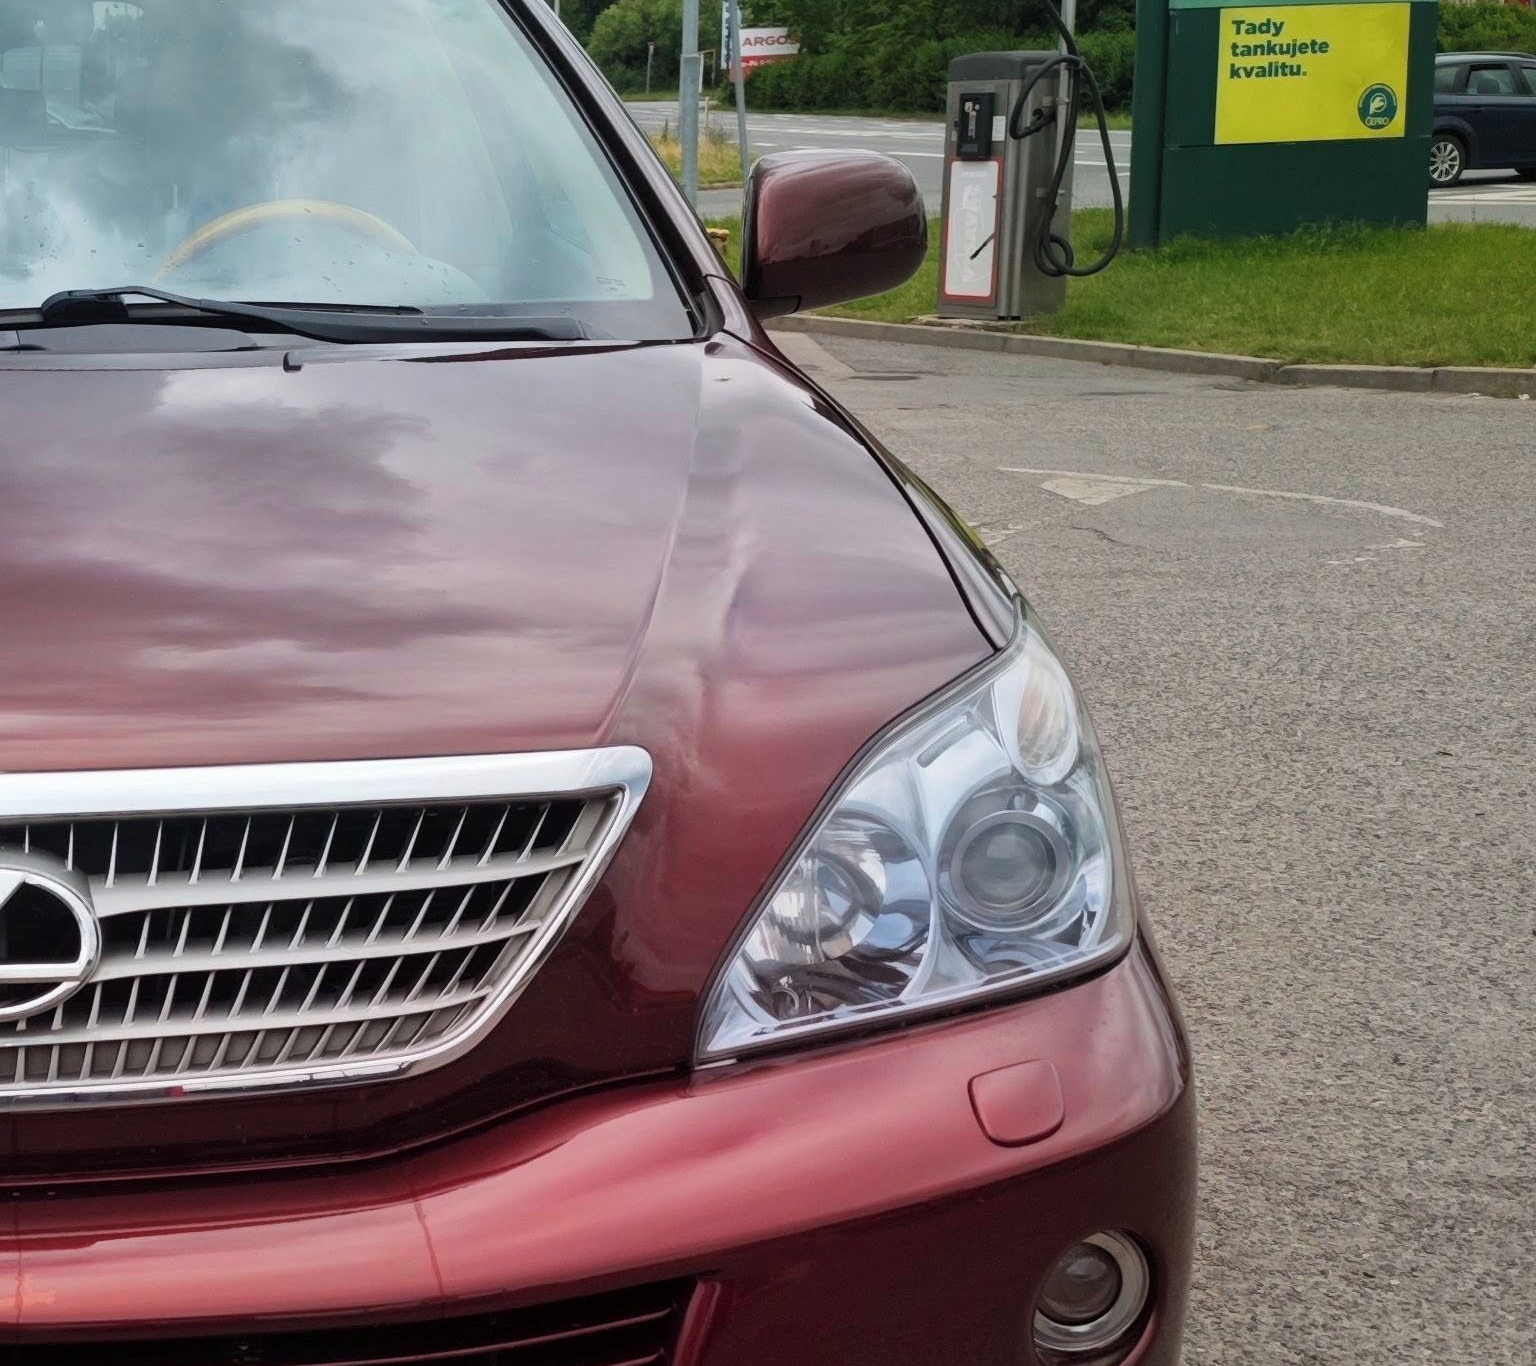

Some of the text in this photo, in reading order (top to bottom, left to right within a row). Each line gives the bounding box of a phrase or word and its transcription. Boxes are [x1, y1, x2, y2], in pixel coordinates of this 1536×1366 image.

[1231, 18, 1285, 37] Tady
[1230, 39, 1330, 58] tankujete
[1229, 61, 1307, 79] kvalitu.
